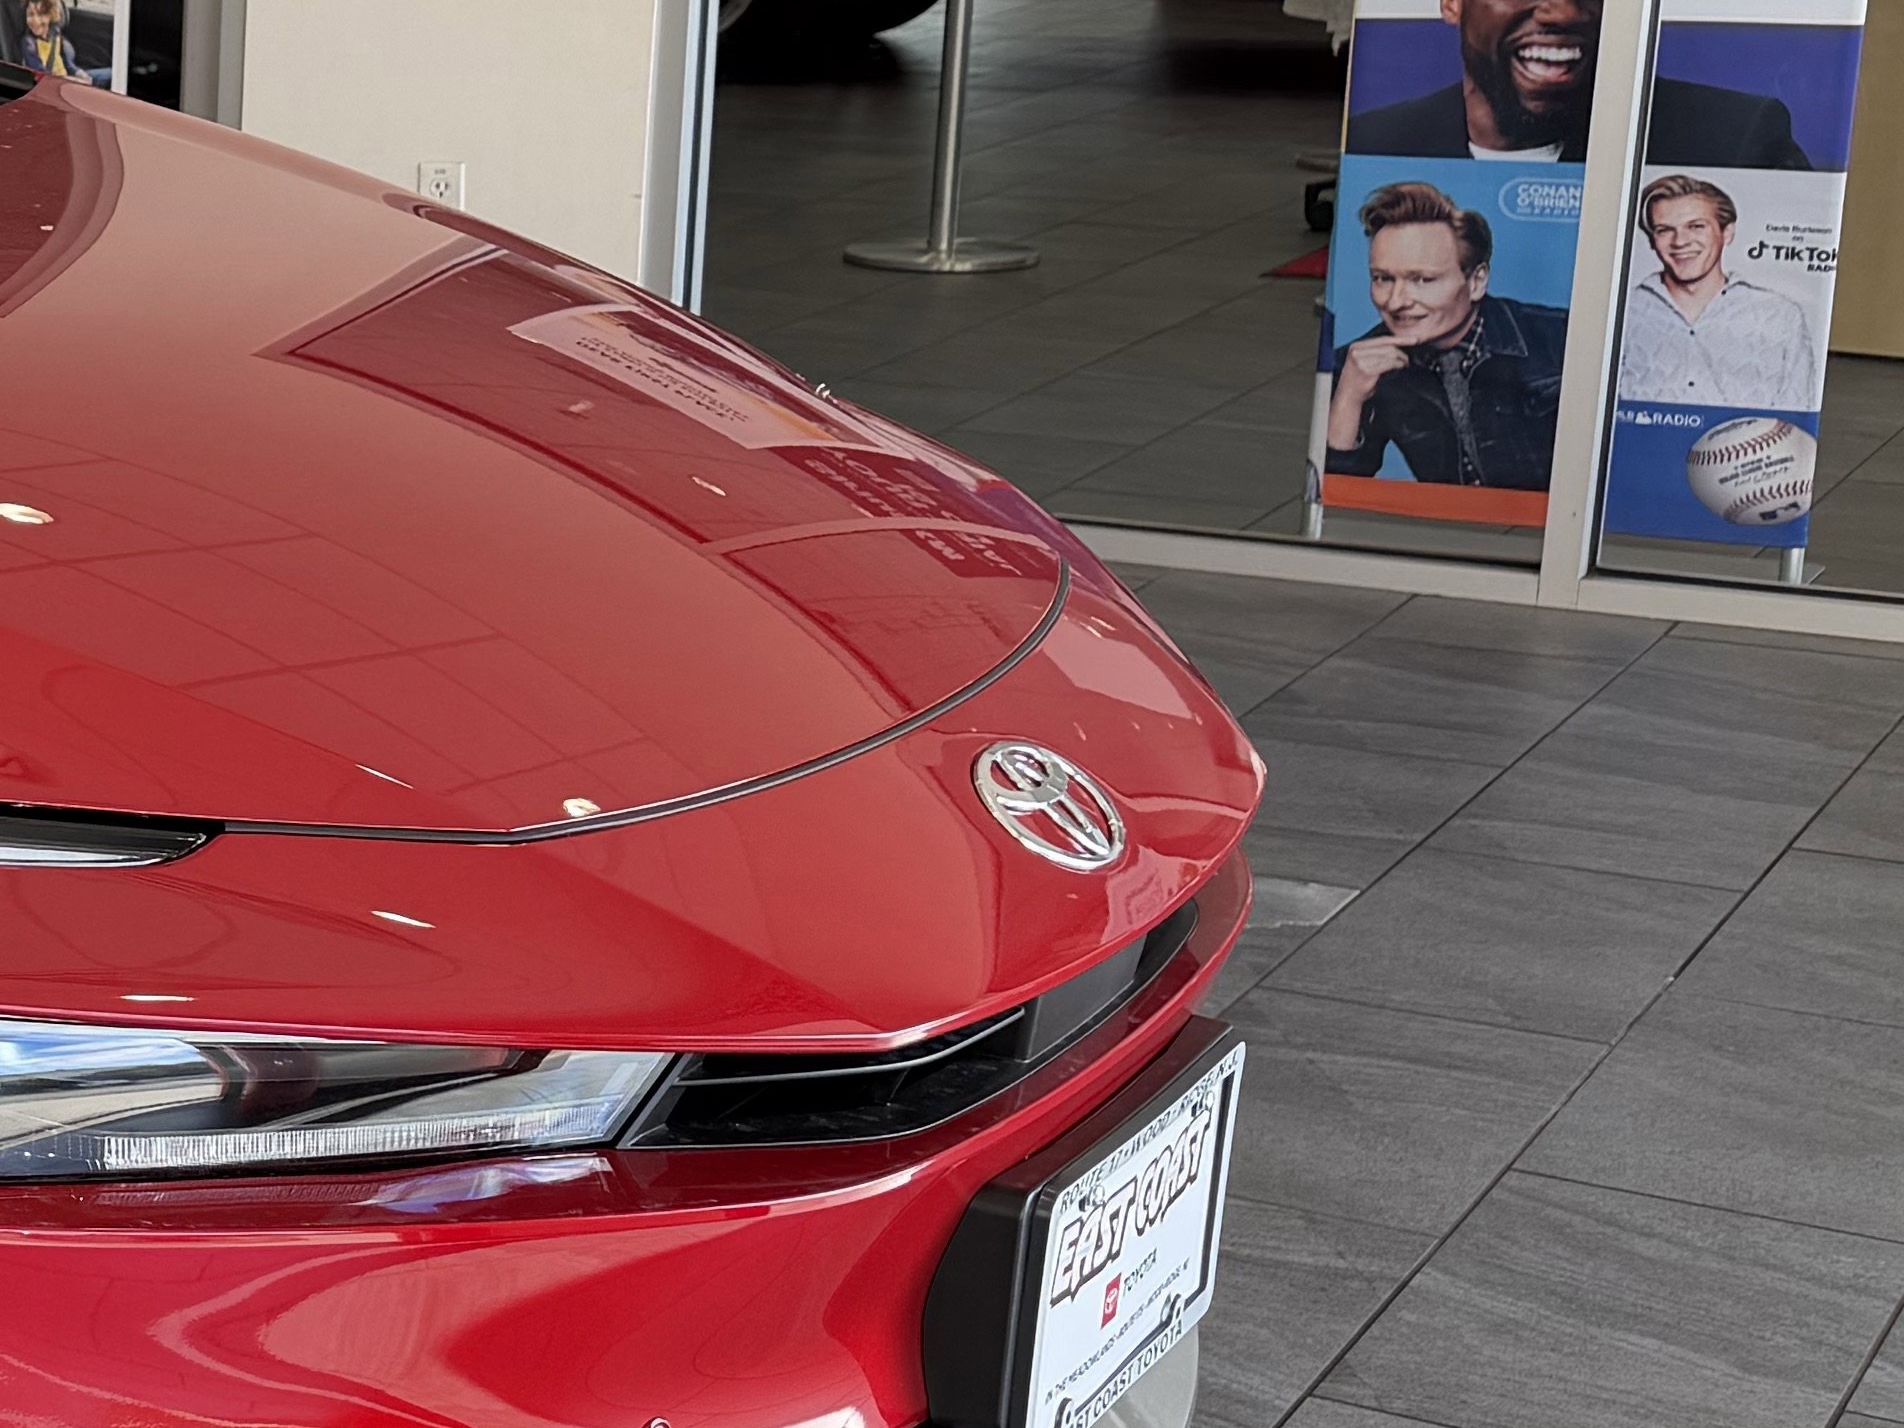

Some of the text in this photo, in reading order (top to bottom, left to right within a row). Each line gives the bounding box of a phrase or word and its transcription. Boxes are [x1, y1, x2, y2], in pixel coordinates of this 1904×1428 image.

[1518, 184, 1581, 199] CONAN
[1654, 412, 1701, 427] RADIO
[1049, 1174, 1137, 1307] EAST
[1134, 1109, 1211, 1239] COAST
[1094, 1363, 1134, 1418] COAST
[1136, 1318, 1182, 1376] TOYOTA
